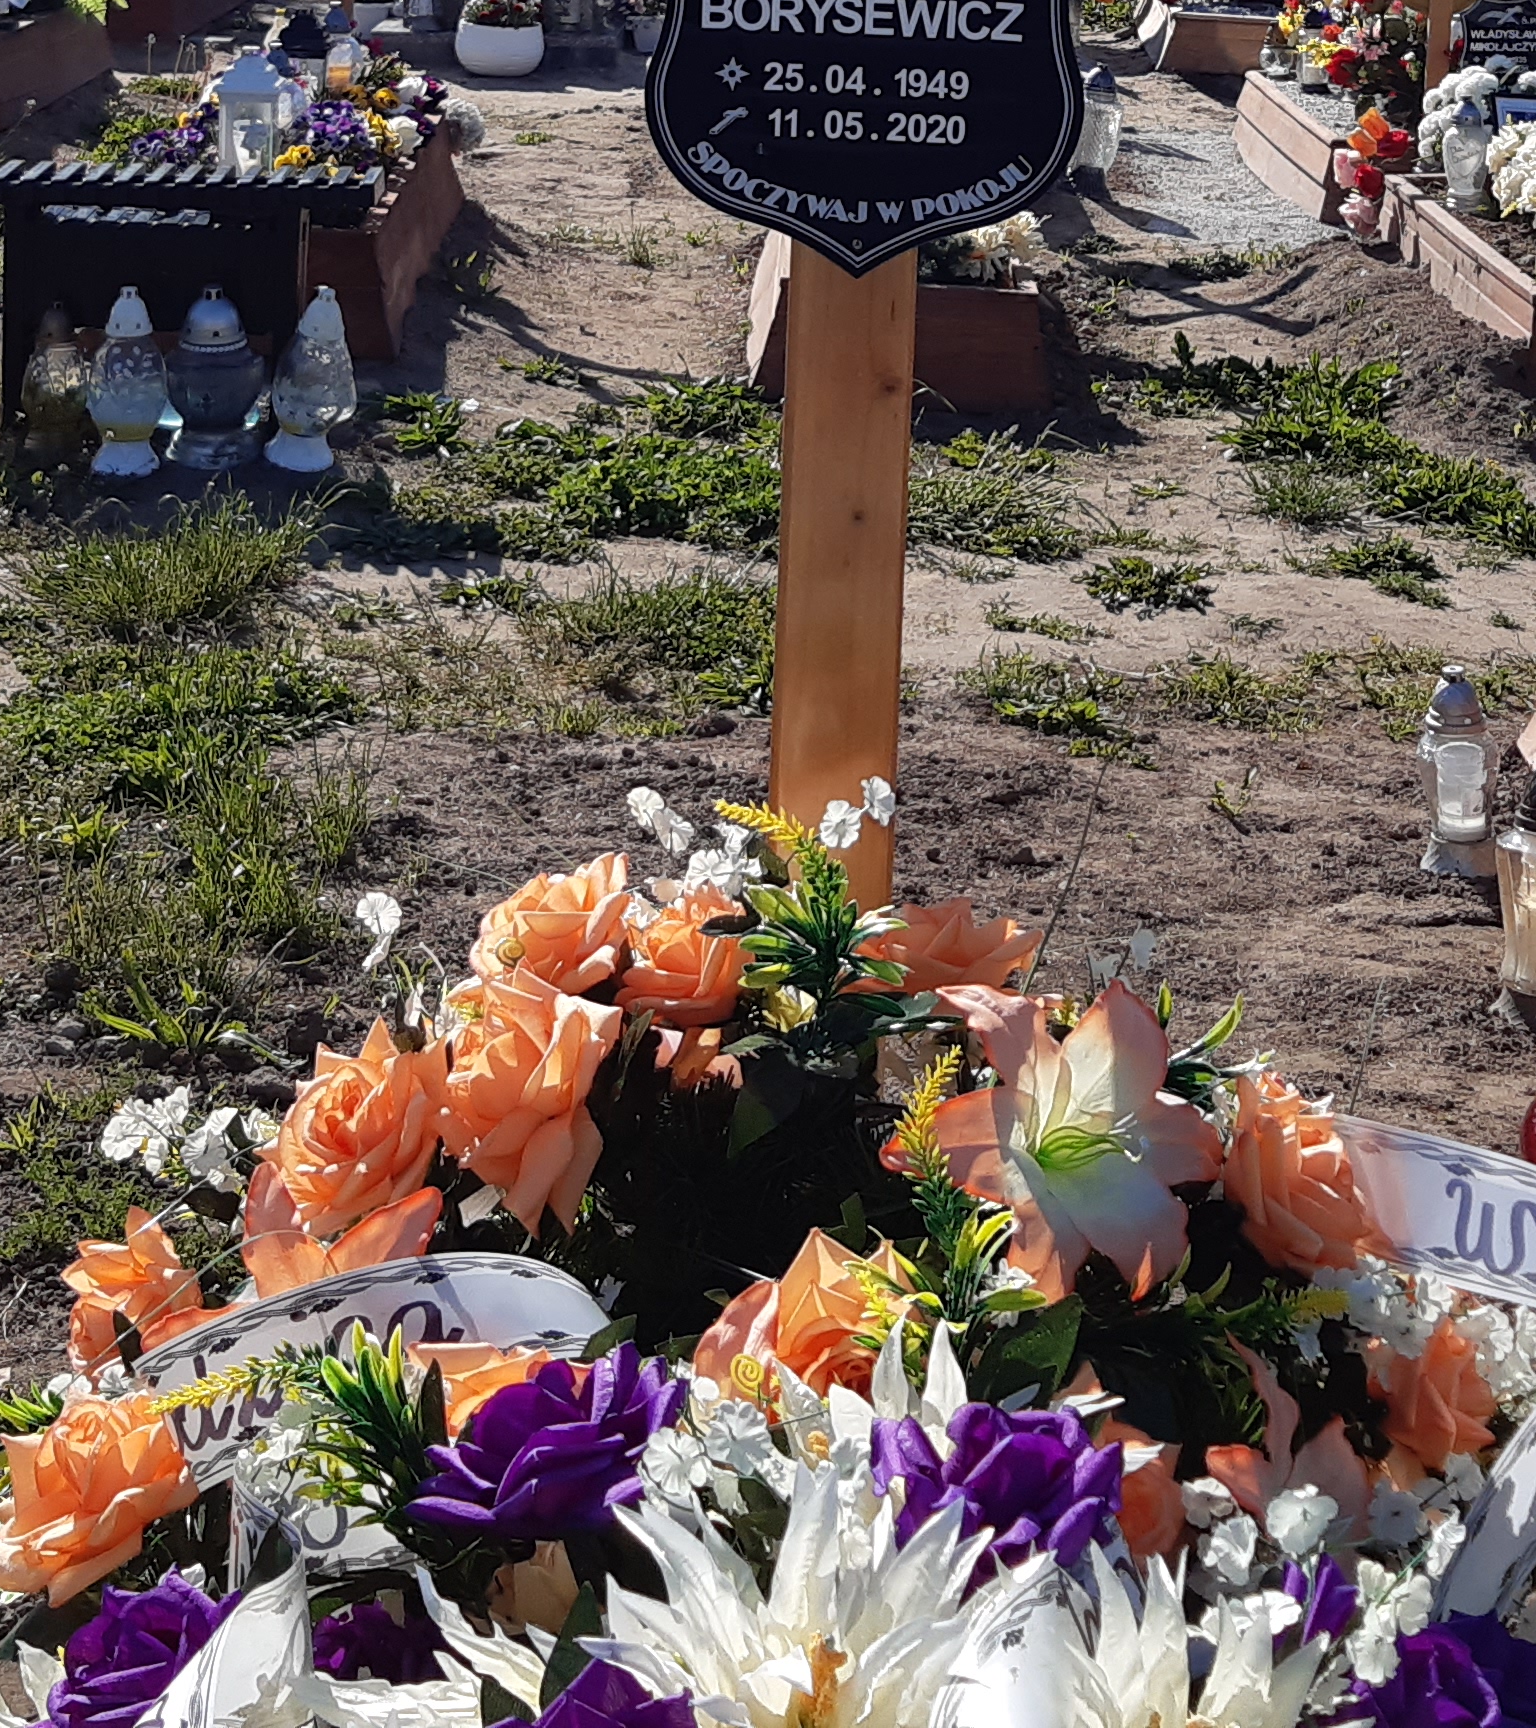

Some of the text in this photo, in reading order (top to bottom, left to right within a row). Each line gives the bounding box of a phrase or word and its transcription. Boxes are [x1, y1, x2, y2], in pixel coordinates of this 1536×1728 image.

[687, 140, 1033, 224] SPOCZYWAJ W POKOJU
